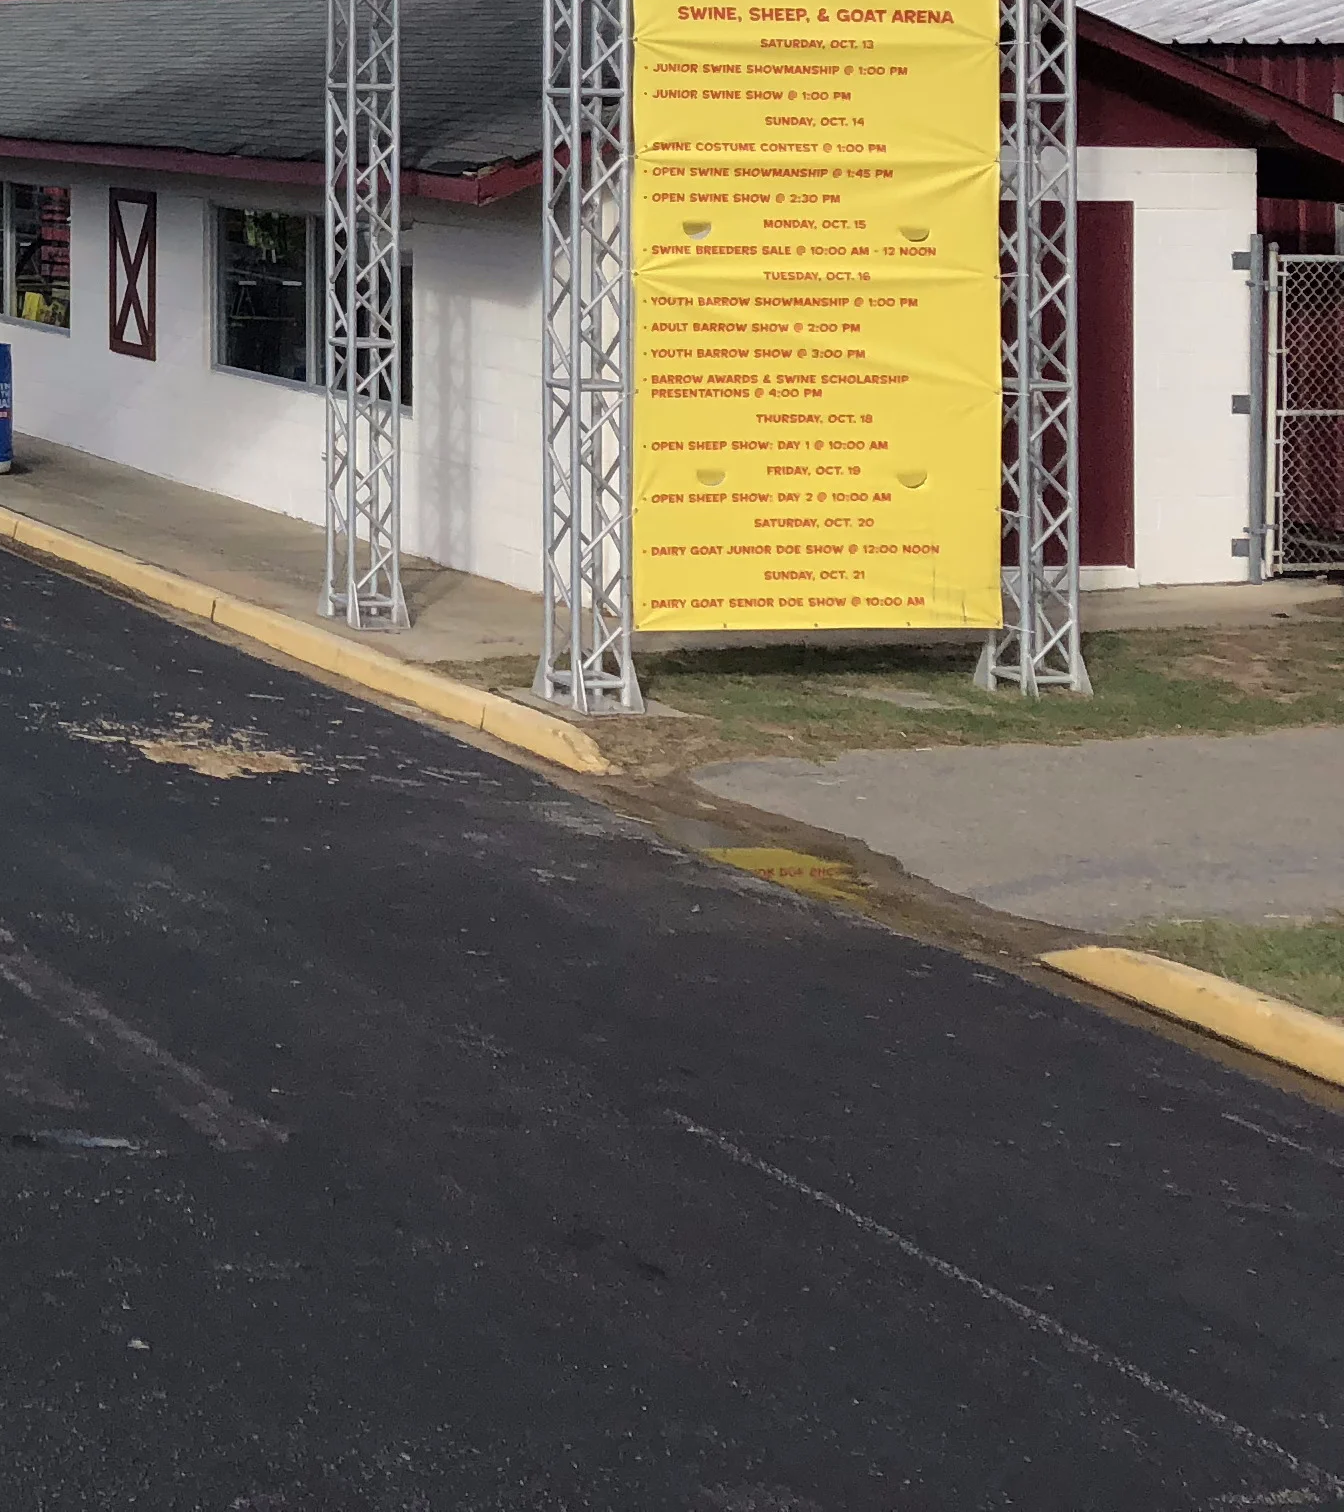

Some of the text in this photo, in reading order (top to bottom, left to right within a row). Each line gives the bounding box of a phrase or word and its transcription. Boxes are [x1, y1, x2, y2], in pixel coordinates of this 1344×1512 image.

[678, 6, 955, 25] SWINE, SHEEP, & GOAT ARENA
[852, 118, 865, 127] 14
[652, 141, 691, 151] SWINE
[695, 142, 756, 153] COSTUME
[759, 143, 818, 153] CONTEST
[837, 143, 864, 153] 1:00
[868, 143, 887, 153] PM
[650, 374, 910, 385] BARROW AWARDS & SWINE SCHOLARSHIP
[651, 388, 750, 399] PRESENTATIONS
[768, 388, 800, 398] 4:00
[803, 388, 824, 399] PM
[853, 570, 865, 580] 21
